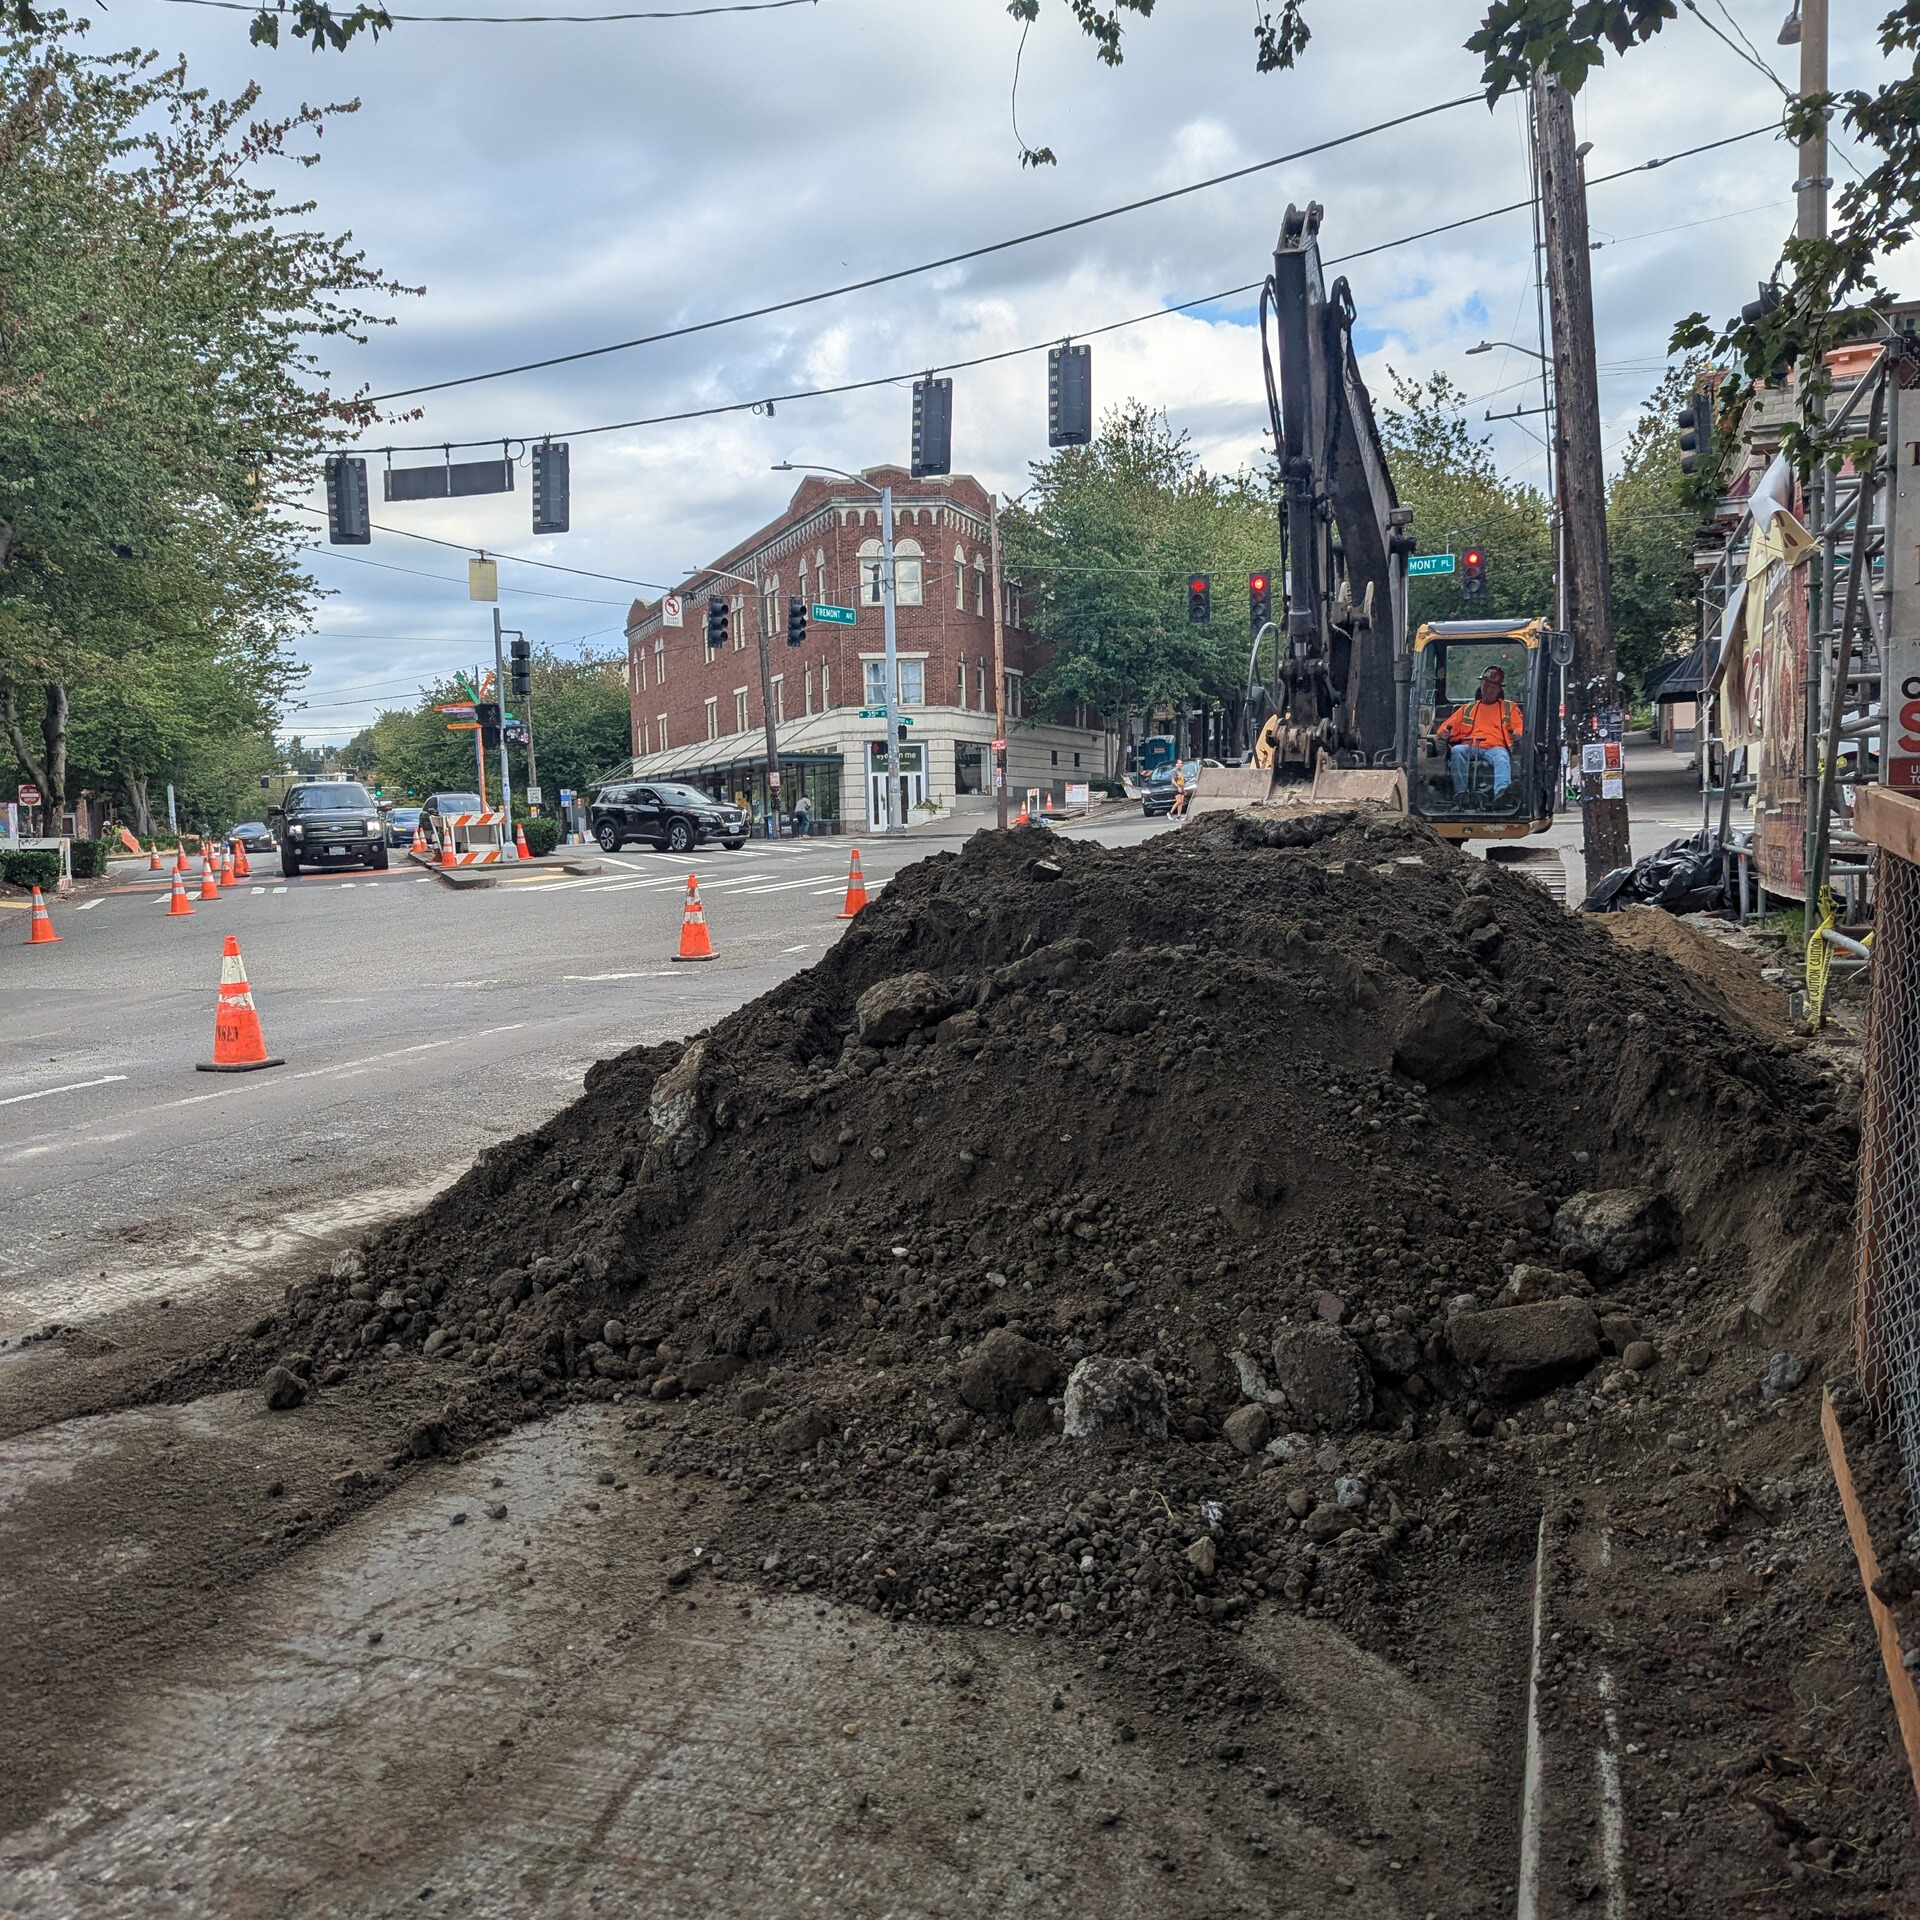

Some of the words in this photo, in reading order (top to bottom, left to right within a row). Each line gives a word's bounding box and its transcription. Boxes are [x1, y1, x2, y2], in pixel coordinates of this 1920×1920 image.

[815, 607, 840, 619] FREMONT
[1809, 937, 1822, 966] CAUTION
[1808, 969, 1820, 997] CAUTION
